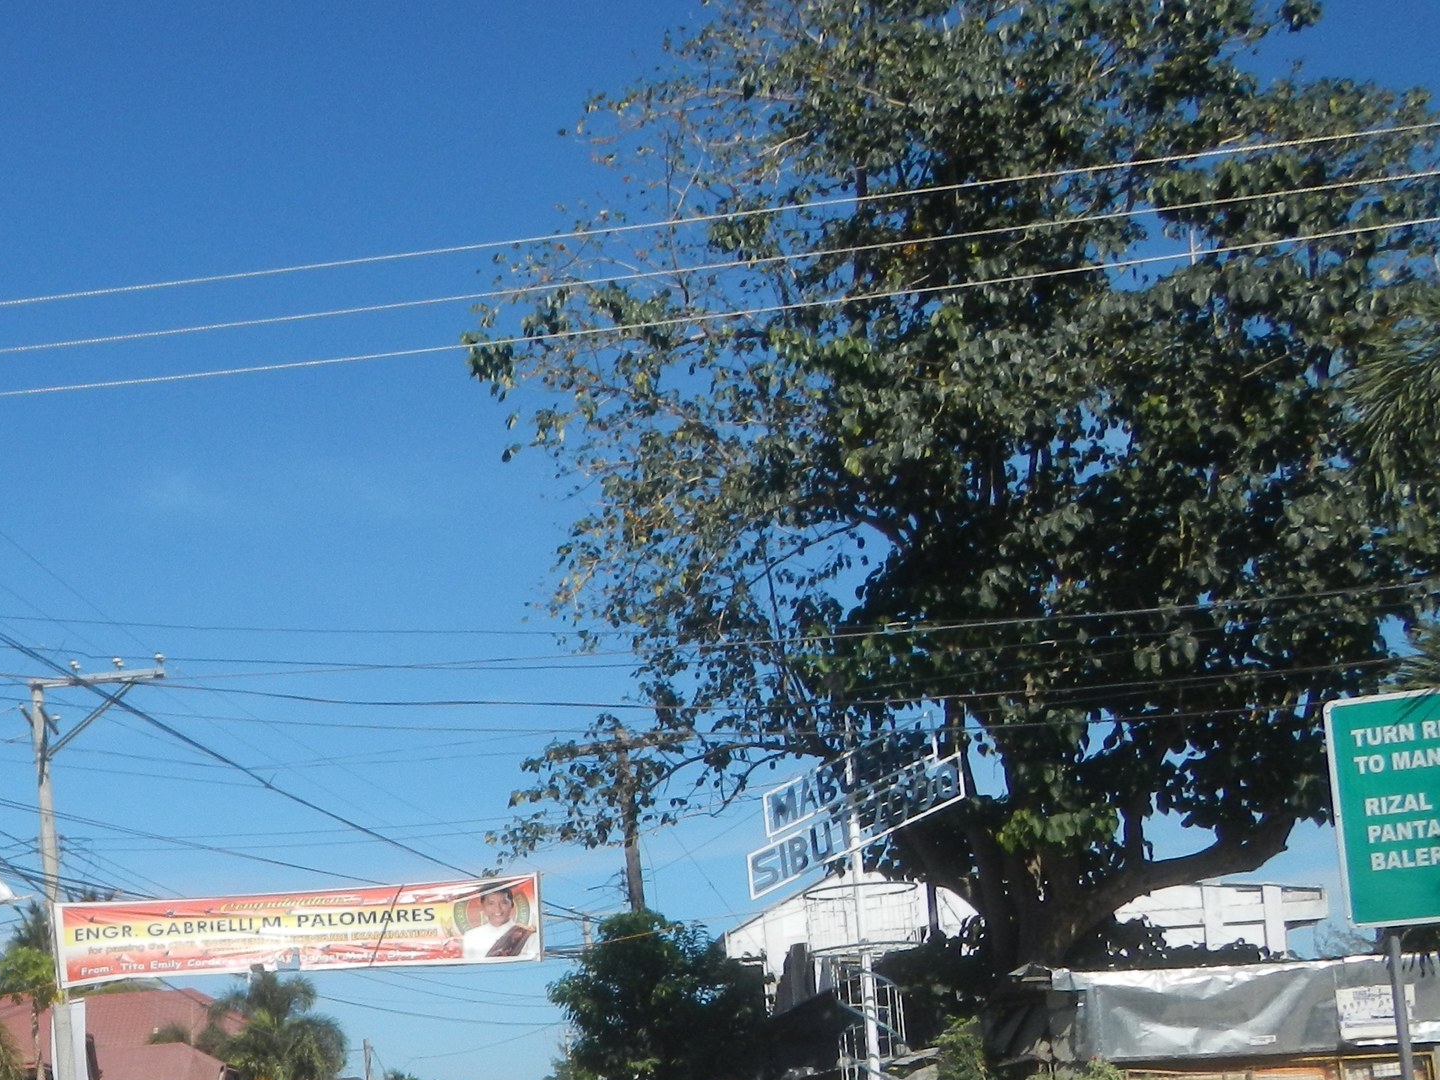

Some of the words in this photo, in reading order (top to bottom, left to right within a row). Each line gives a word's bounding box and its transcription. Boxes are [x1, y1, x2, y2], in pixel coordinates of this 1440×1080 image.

[1350, 722, 1415, 747] TURN
[1353, 754, 1384, 775] TO
[1364, 792, 1433, 816] RIZAL
[74, 925, 138, 942] ENGR.
[298, 907, 436, 928] PALOMARES
[88, 946, 103, 955] for
[105, 943, 144, 954] passing
[148, 941, 165, 952] the
[81, 965, 114, 976] From:
[120, 962, 145, 971] Tita
[150, 959, 181, 971] Emily
